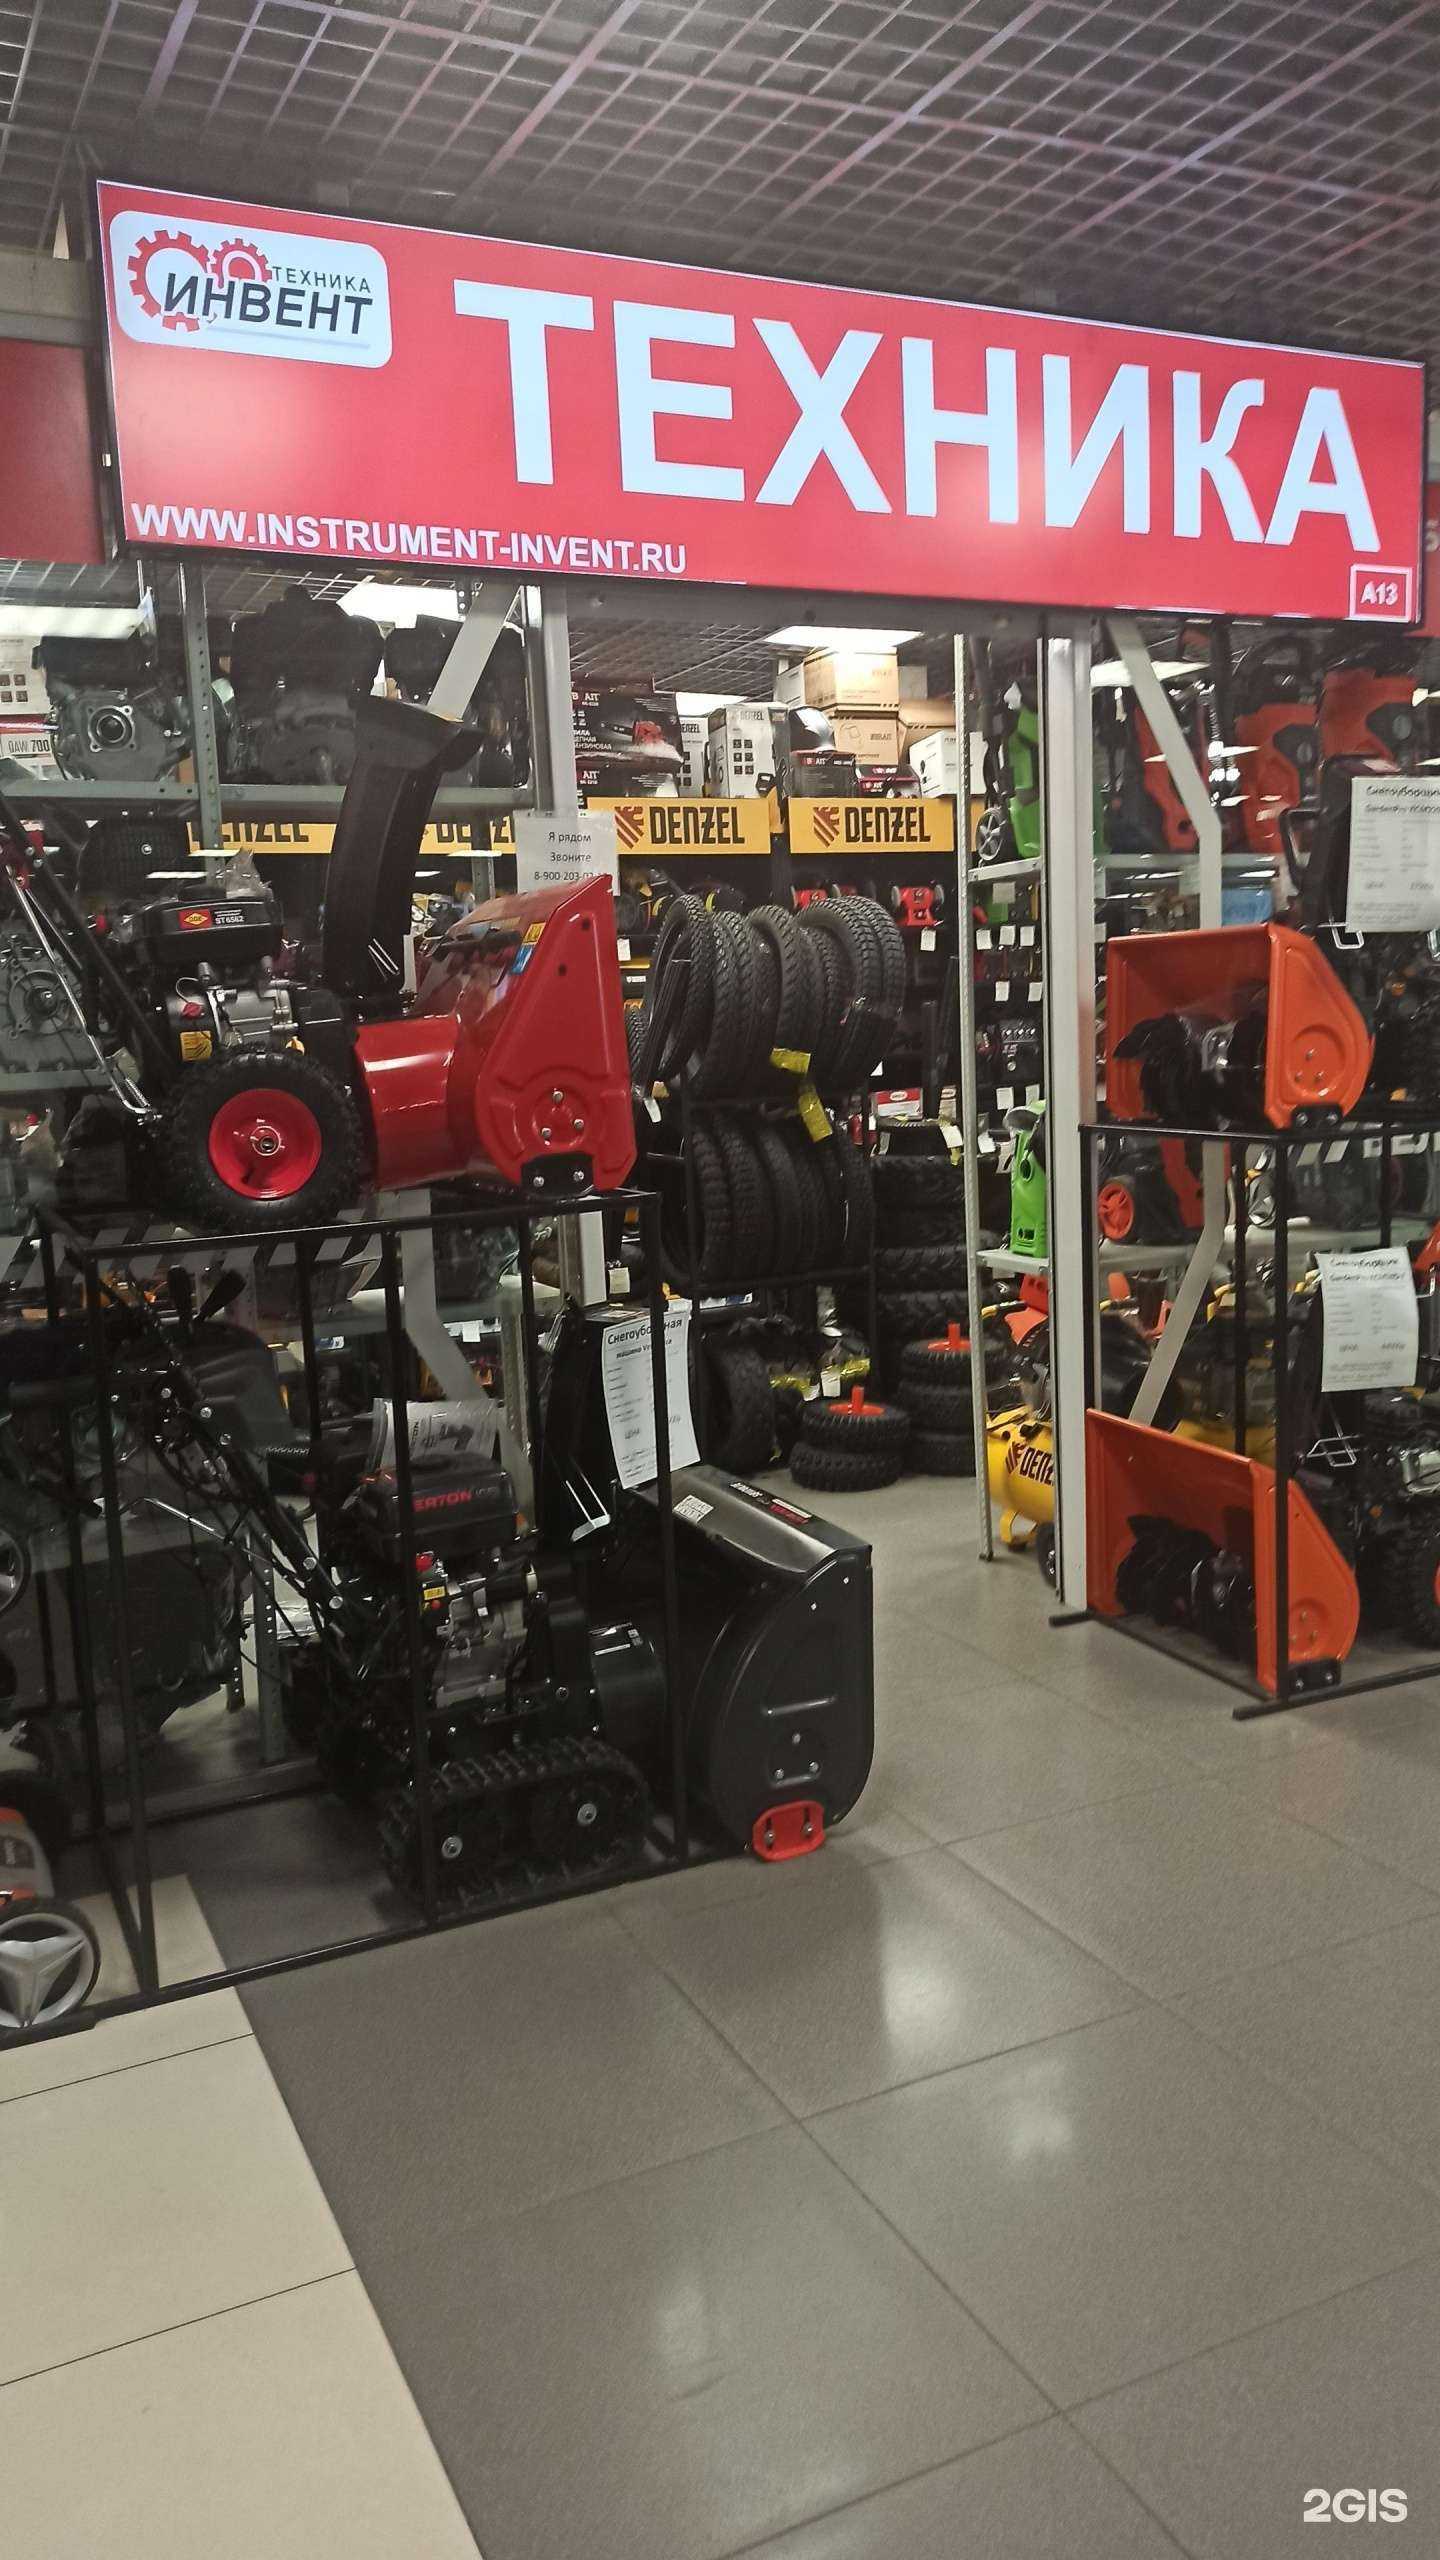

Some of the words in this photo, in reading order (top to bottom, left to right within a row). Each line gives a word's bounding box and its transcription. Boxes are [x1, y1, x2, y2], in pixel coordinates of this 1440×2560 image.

[271, 265, 372, 293] ТЕХНИКА
[163, 273, 373, 335] ИНВЕНТ
[453, 279, 1381, 553] ТЕХНИКА
[131, 503, 687, 574] WWW.INSTRUMENT-INVENT.RU
[548, 832, 556, 842] Я
[559, 833, 592, 843] рядом
[650, 806, 745, 845] DENZEL
[845, 806, 931, 843] DENZEL
[550, 852, 592, 863] Звоните
[412, 1489, 472, 1513] ERTON
